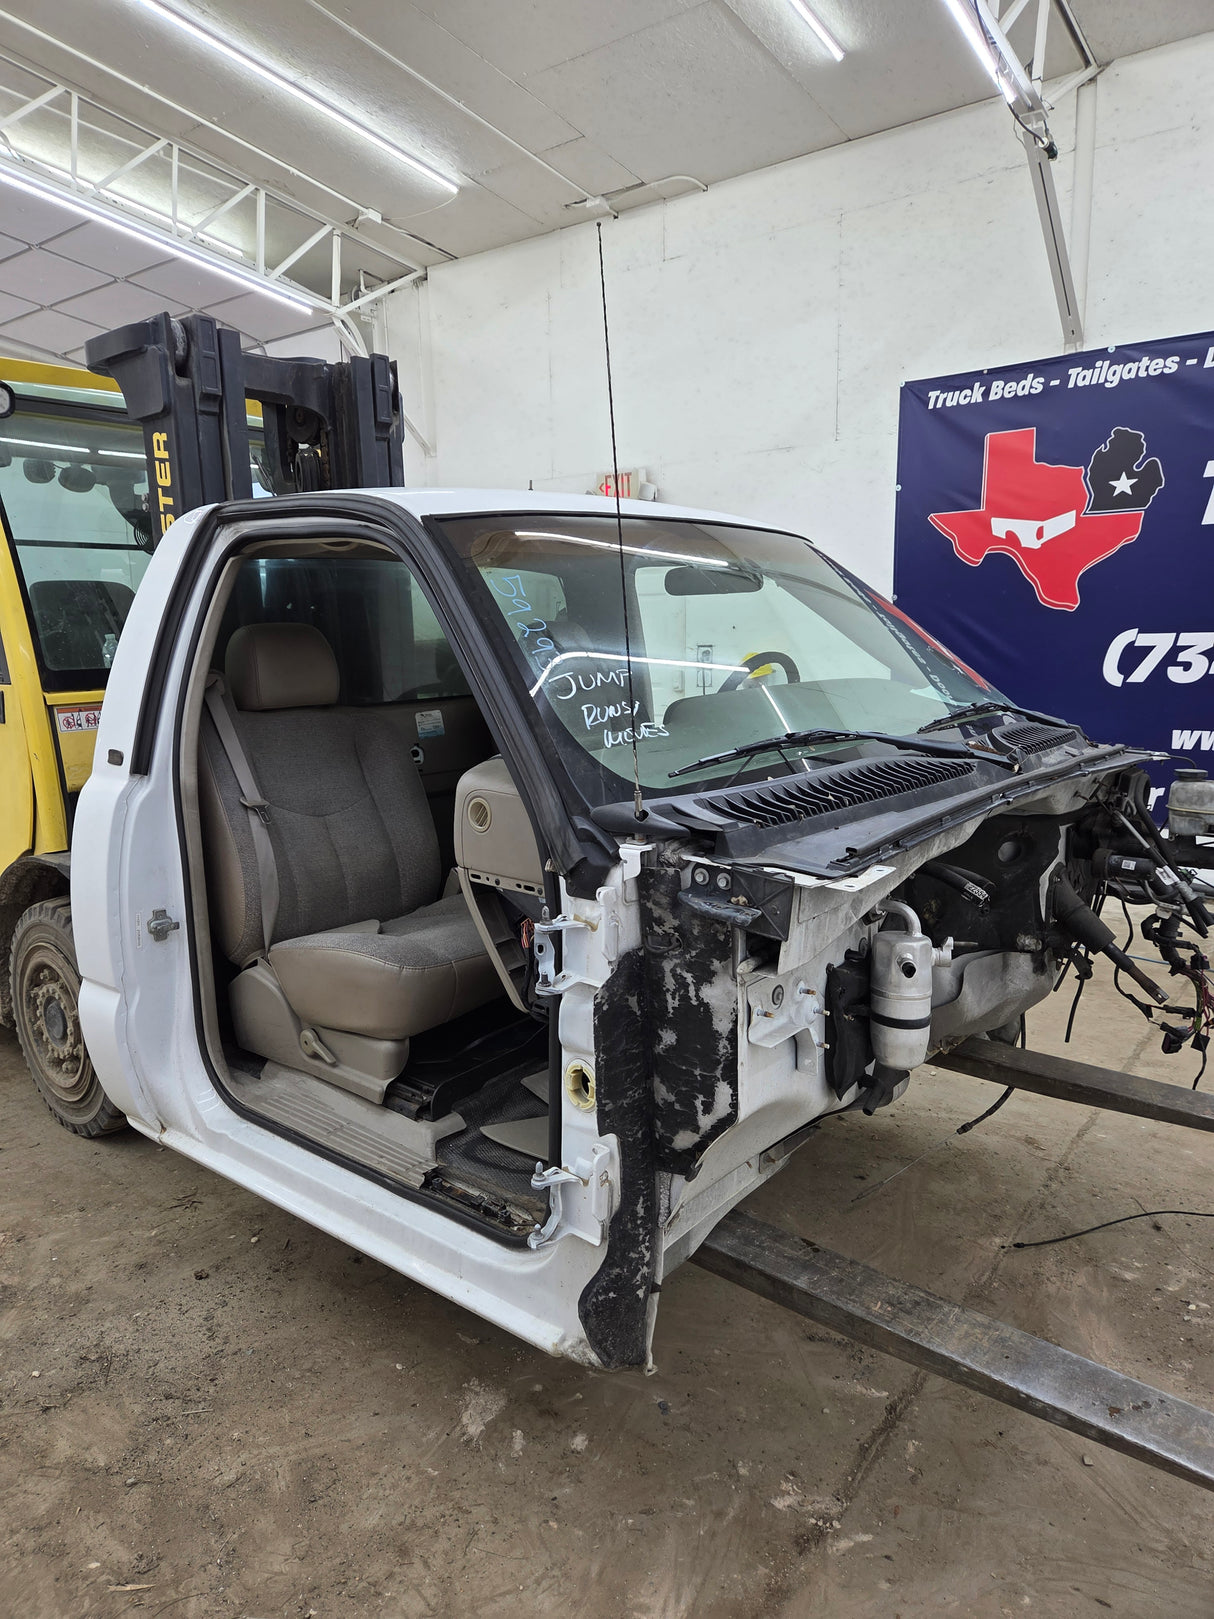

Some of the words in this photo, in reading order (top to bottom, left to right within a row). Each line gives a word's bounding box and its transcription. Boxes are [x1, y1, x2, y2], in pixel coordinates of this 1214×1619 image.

[927, 382, 986, 410] Truck
[988, 373, 1044, 401] Beds
[1067, 355, 1179, 389] Tailgates
[604, 471, 632, 498] EXIT
[1102, 627, 1214, 688] (73
